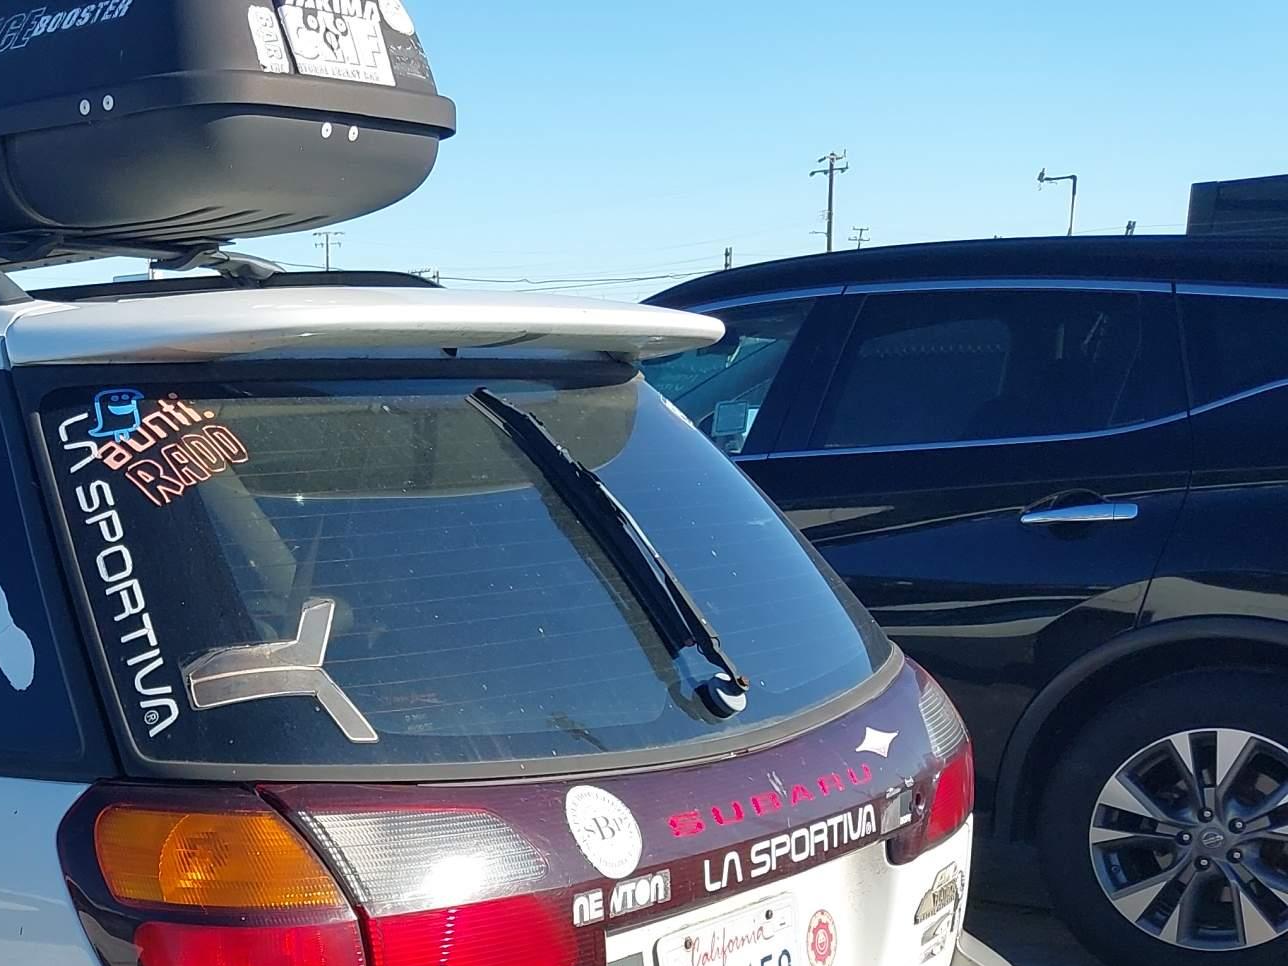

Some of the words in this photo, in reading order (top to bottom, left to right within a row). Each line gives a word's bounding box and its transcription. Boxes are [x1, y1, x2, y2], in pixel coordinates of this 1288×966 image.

[31, 0, 133, 37] BOOSTER
[59, 412, 101, 473] LA
[667, 762, 873, 838] SUBARU
[704, 851, 743, 892] LA
